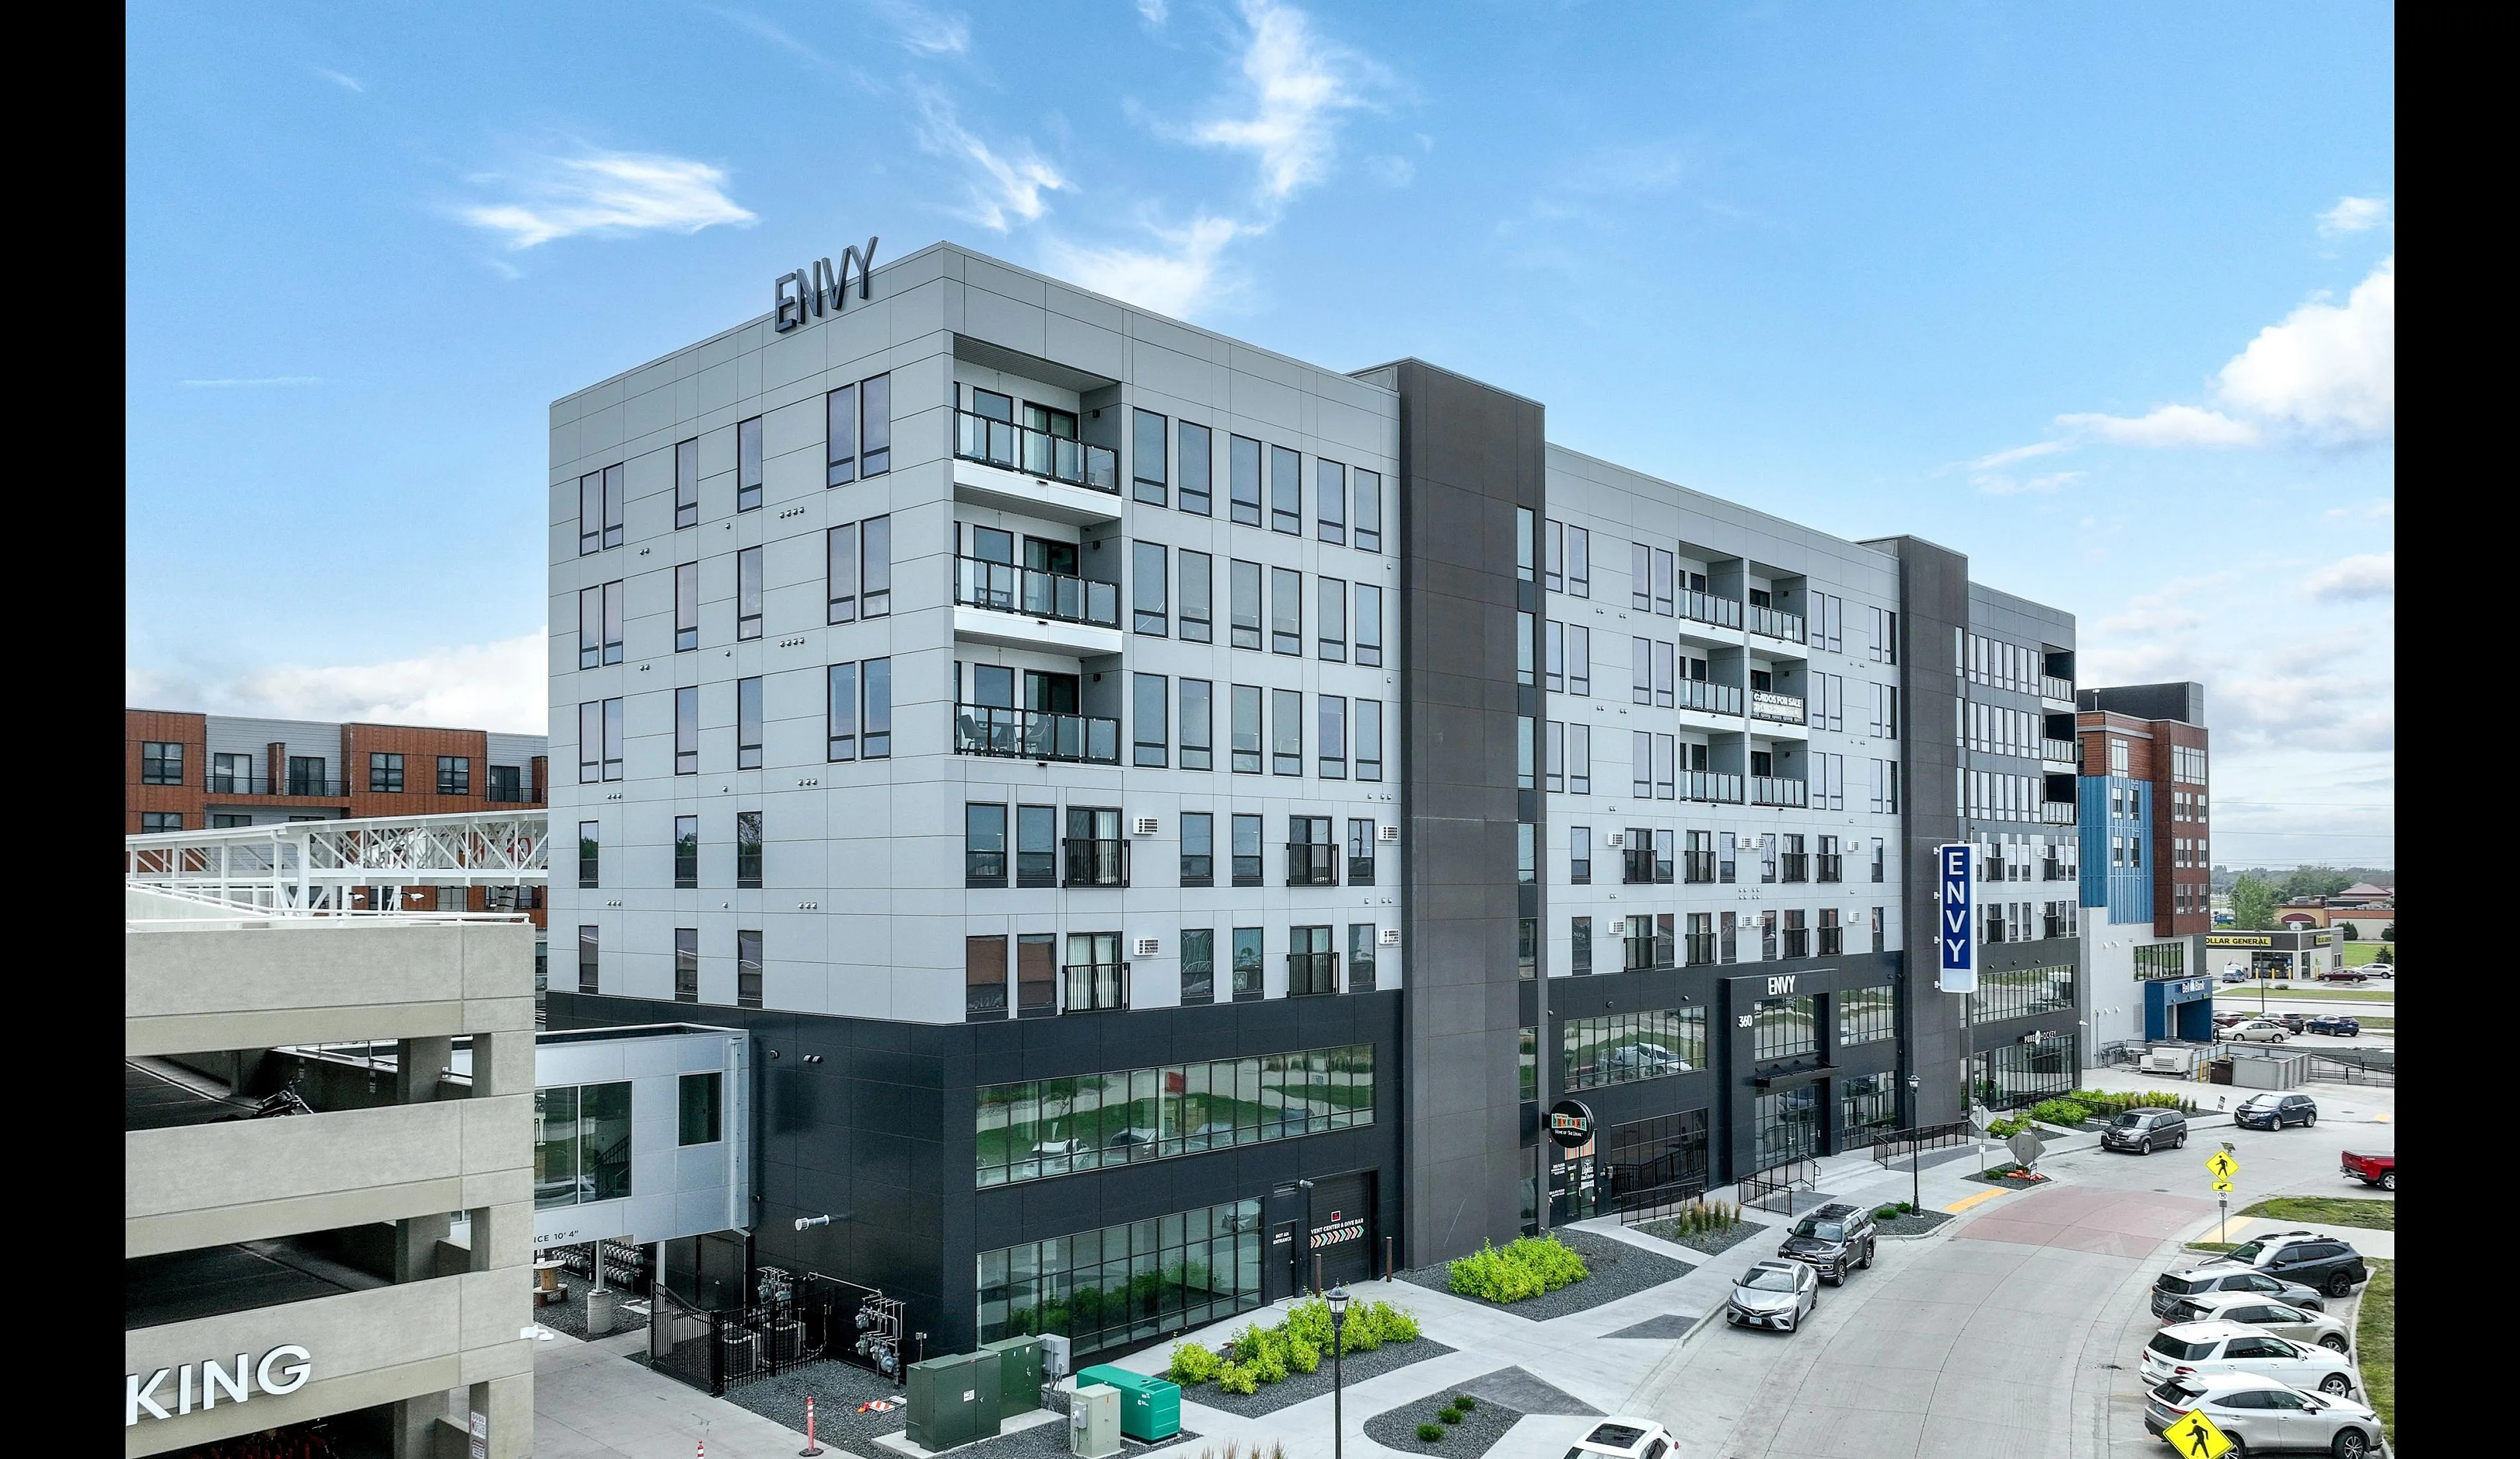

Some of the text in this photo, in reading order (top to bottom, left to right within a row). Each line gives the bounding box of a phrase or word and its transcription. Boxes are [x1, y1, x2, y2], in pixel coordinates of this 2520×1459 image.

[775, 236, 878, 333] ENVY
[1754, 693, 1777, 703] CONDOS
[1788, 697, 1801, 707] SALE
[1945, 852, 1966, 962] ENVY
[1768, 976, 1795, 995] ENVY
[1738, 1015, 1752, 1028] 360
[2025, 1034, 2035, 1043] PURE
[126, 1343, 312, 1427] KING
